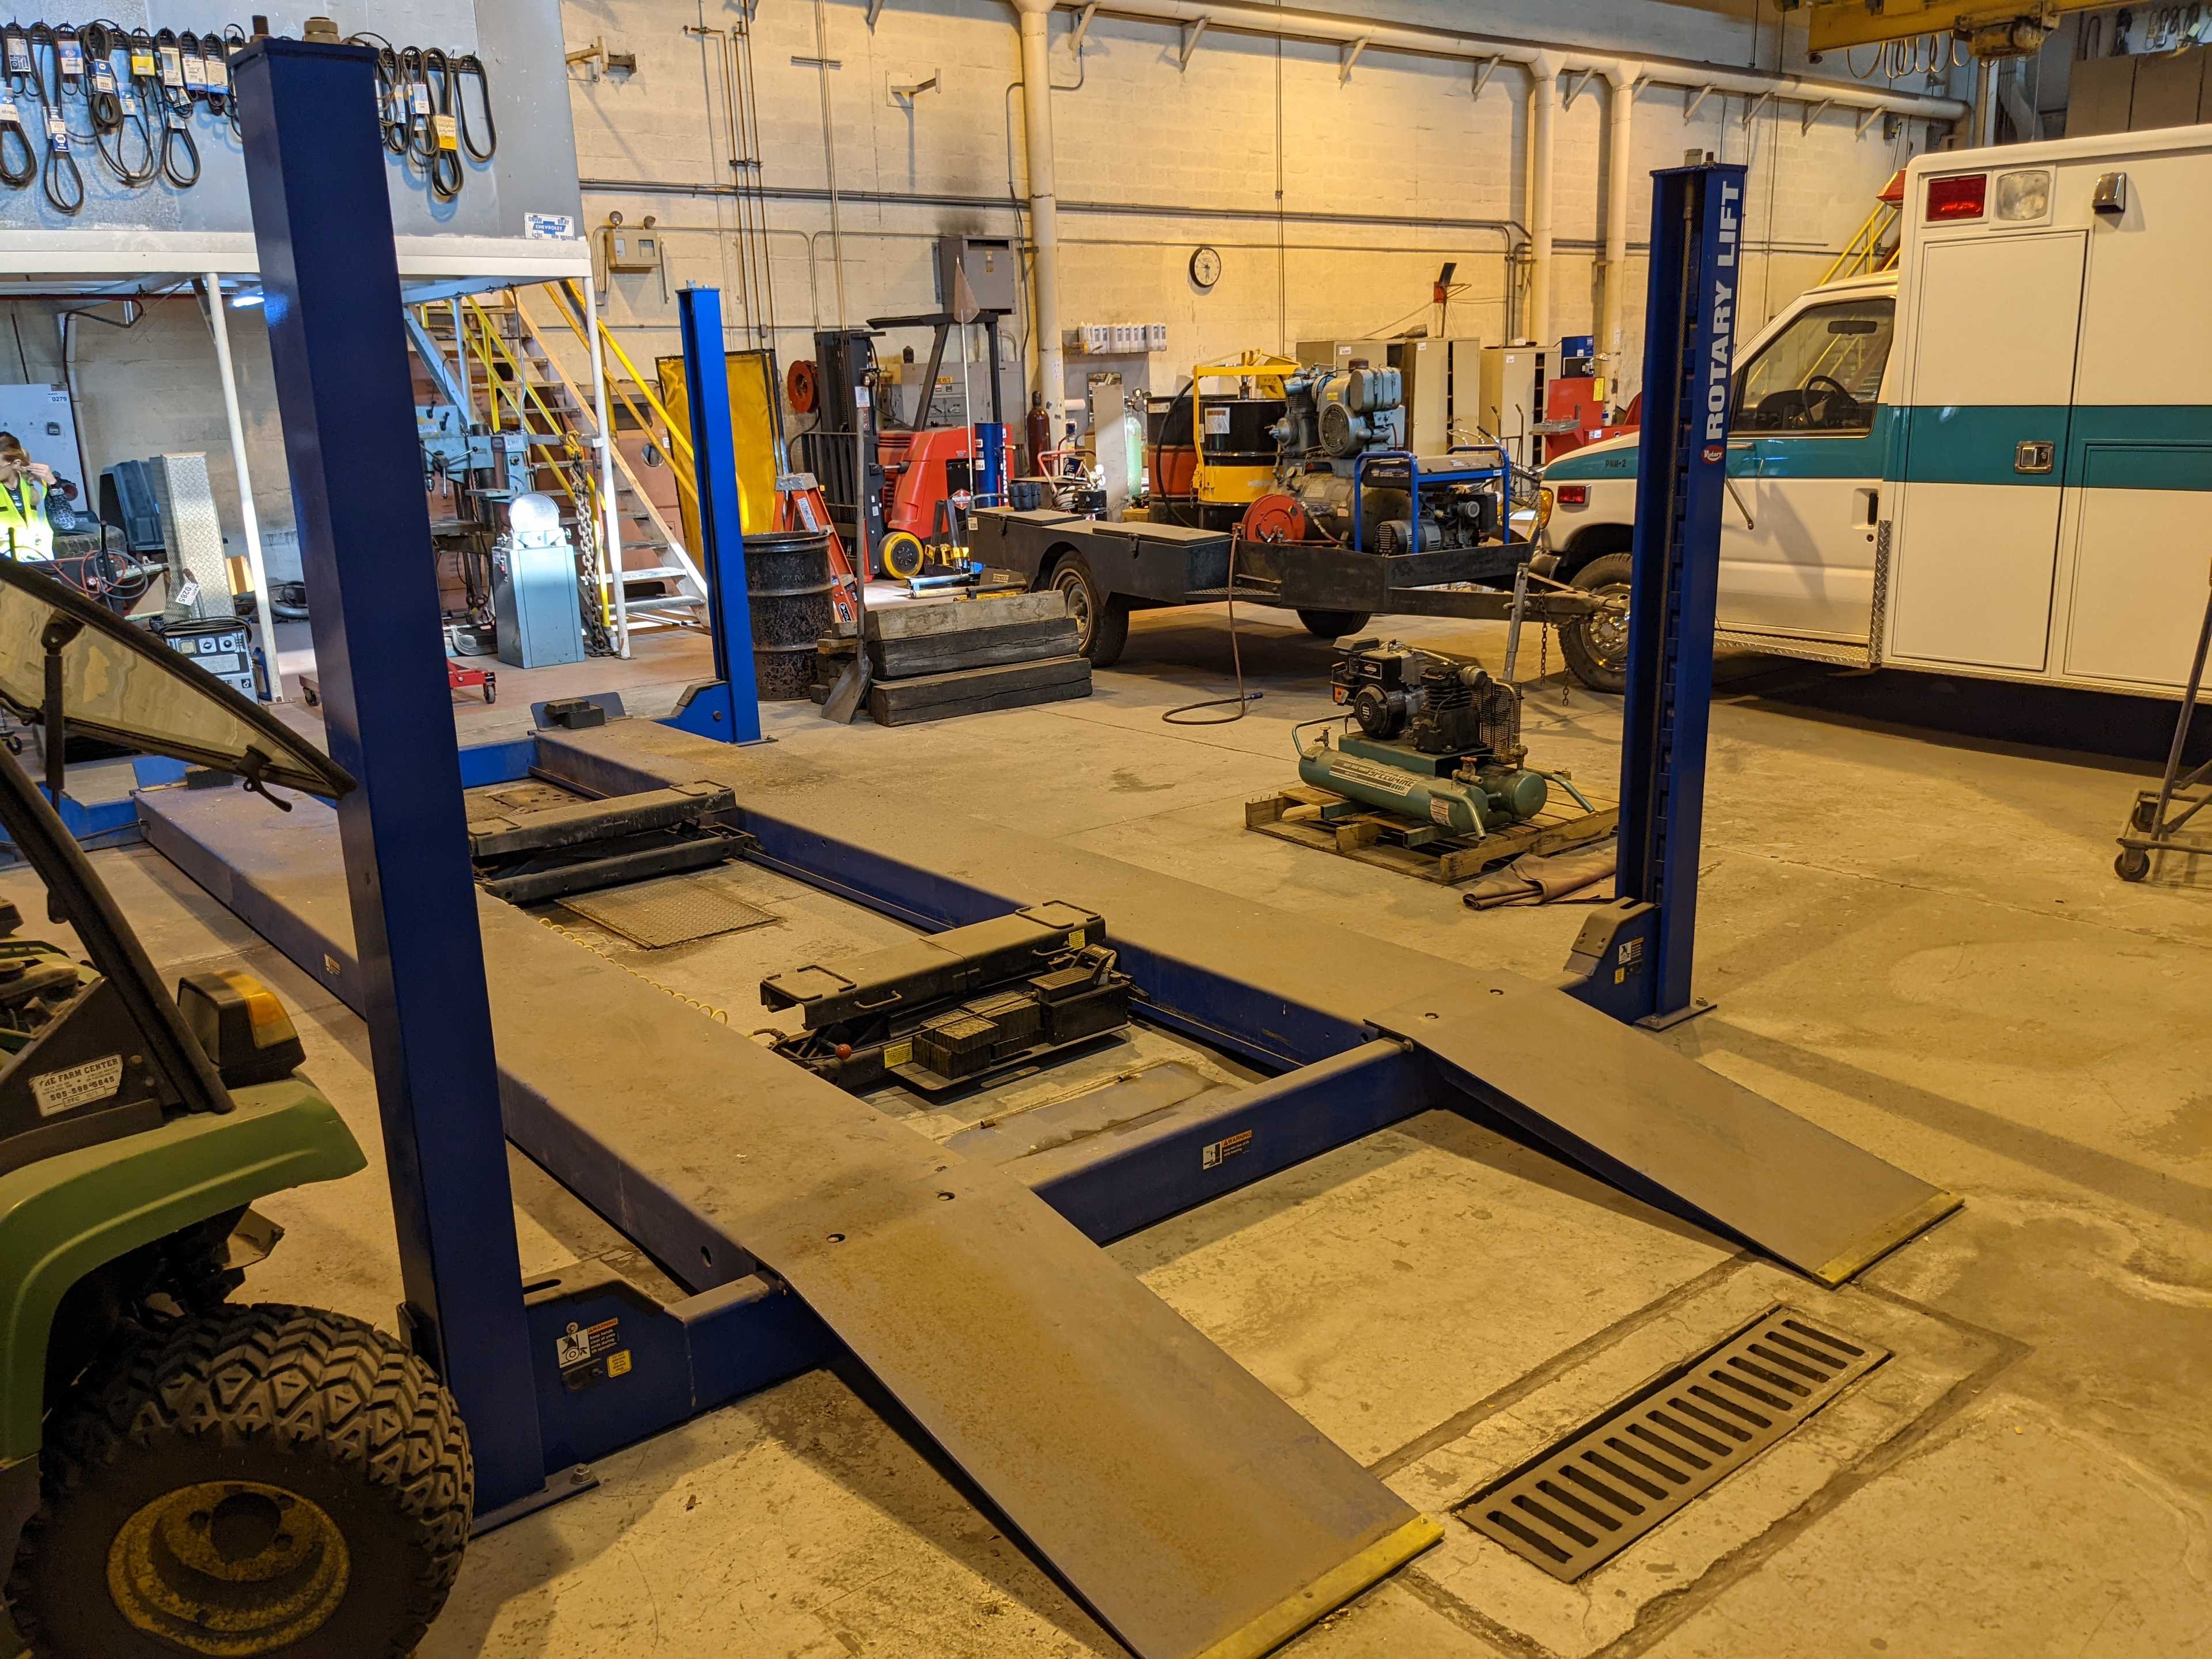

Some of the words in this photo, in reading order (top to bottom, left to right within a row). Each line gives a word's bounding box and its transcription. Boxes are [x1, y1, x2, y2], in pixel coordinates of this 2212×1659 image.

[1717, 181, 1738, 267] LIFT
[1706, 280, 1732, 440] ROTARY
[1704, 449, 1723, 461] Rotary
[178, 586, 192, 603] 0285
[1368, 768, 1419, 787] SPEEDAIRE
[58, 1069, 82, 1082] FARM
[84, 1058, 119, 1074] CENTER
[1226, 1131, 1251, 1145] WARNING
